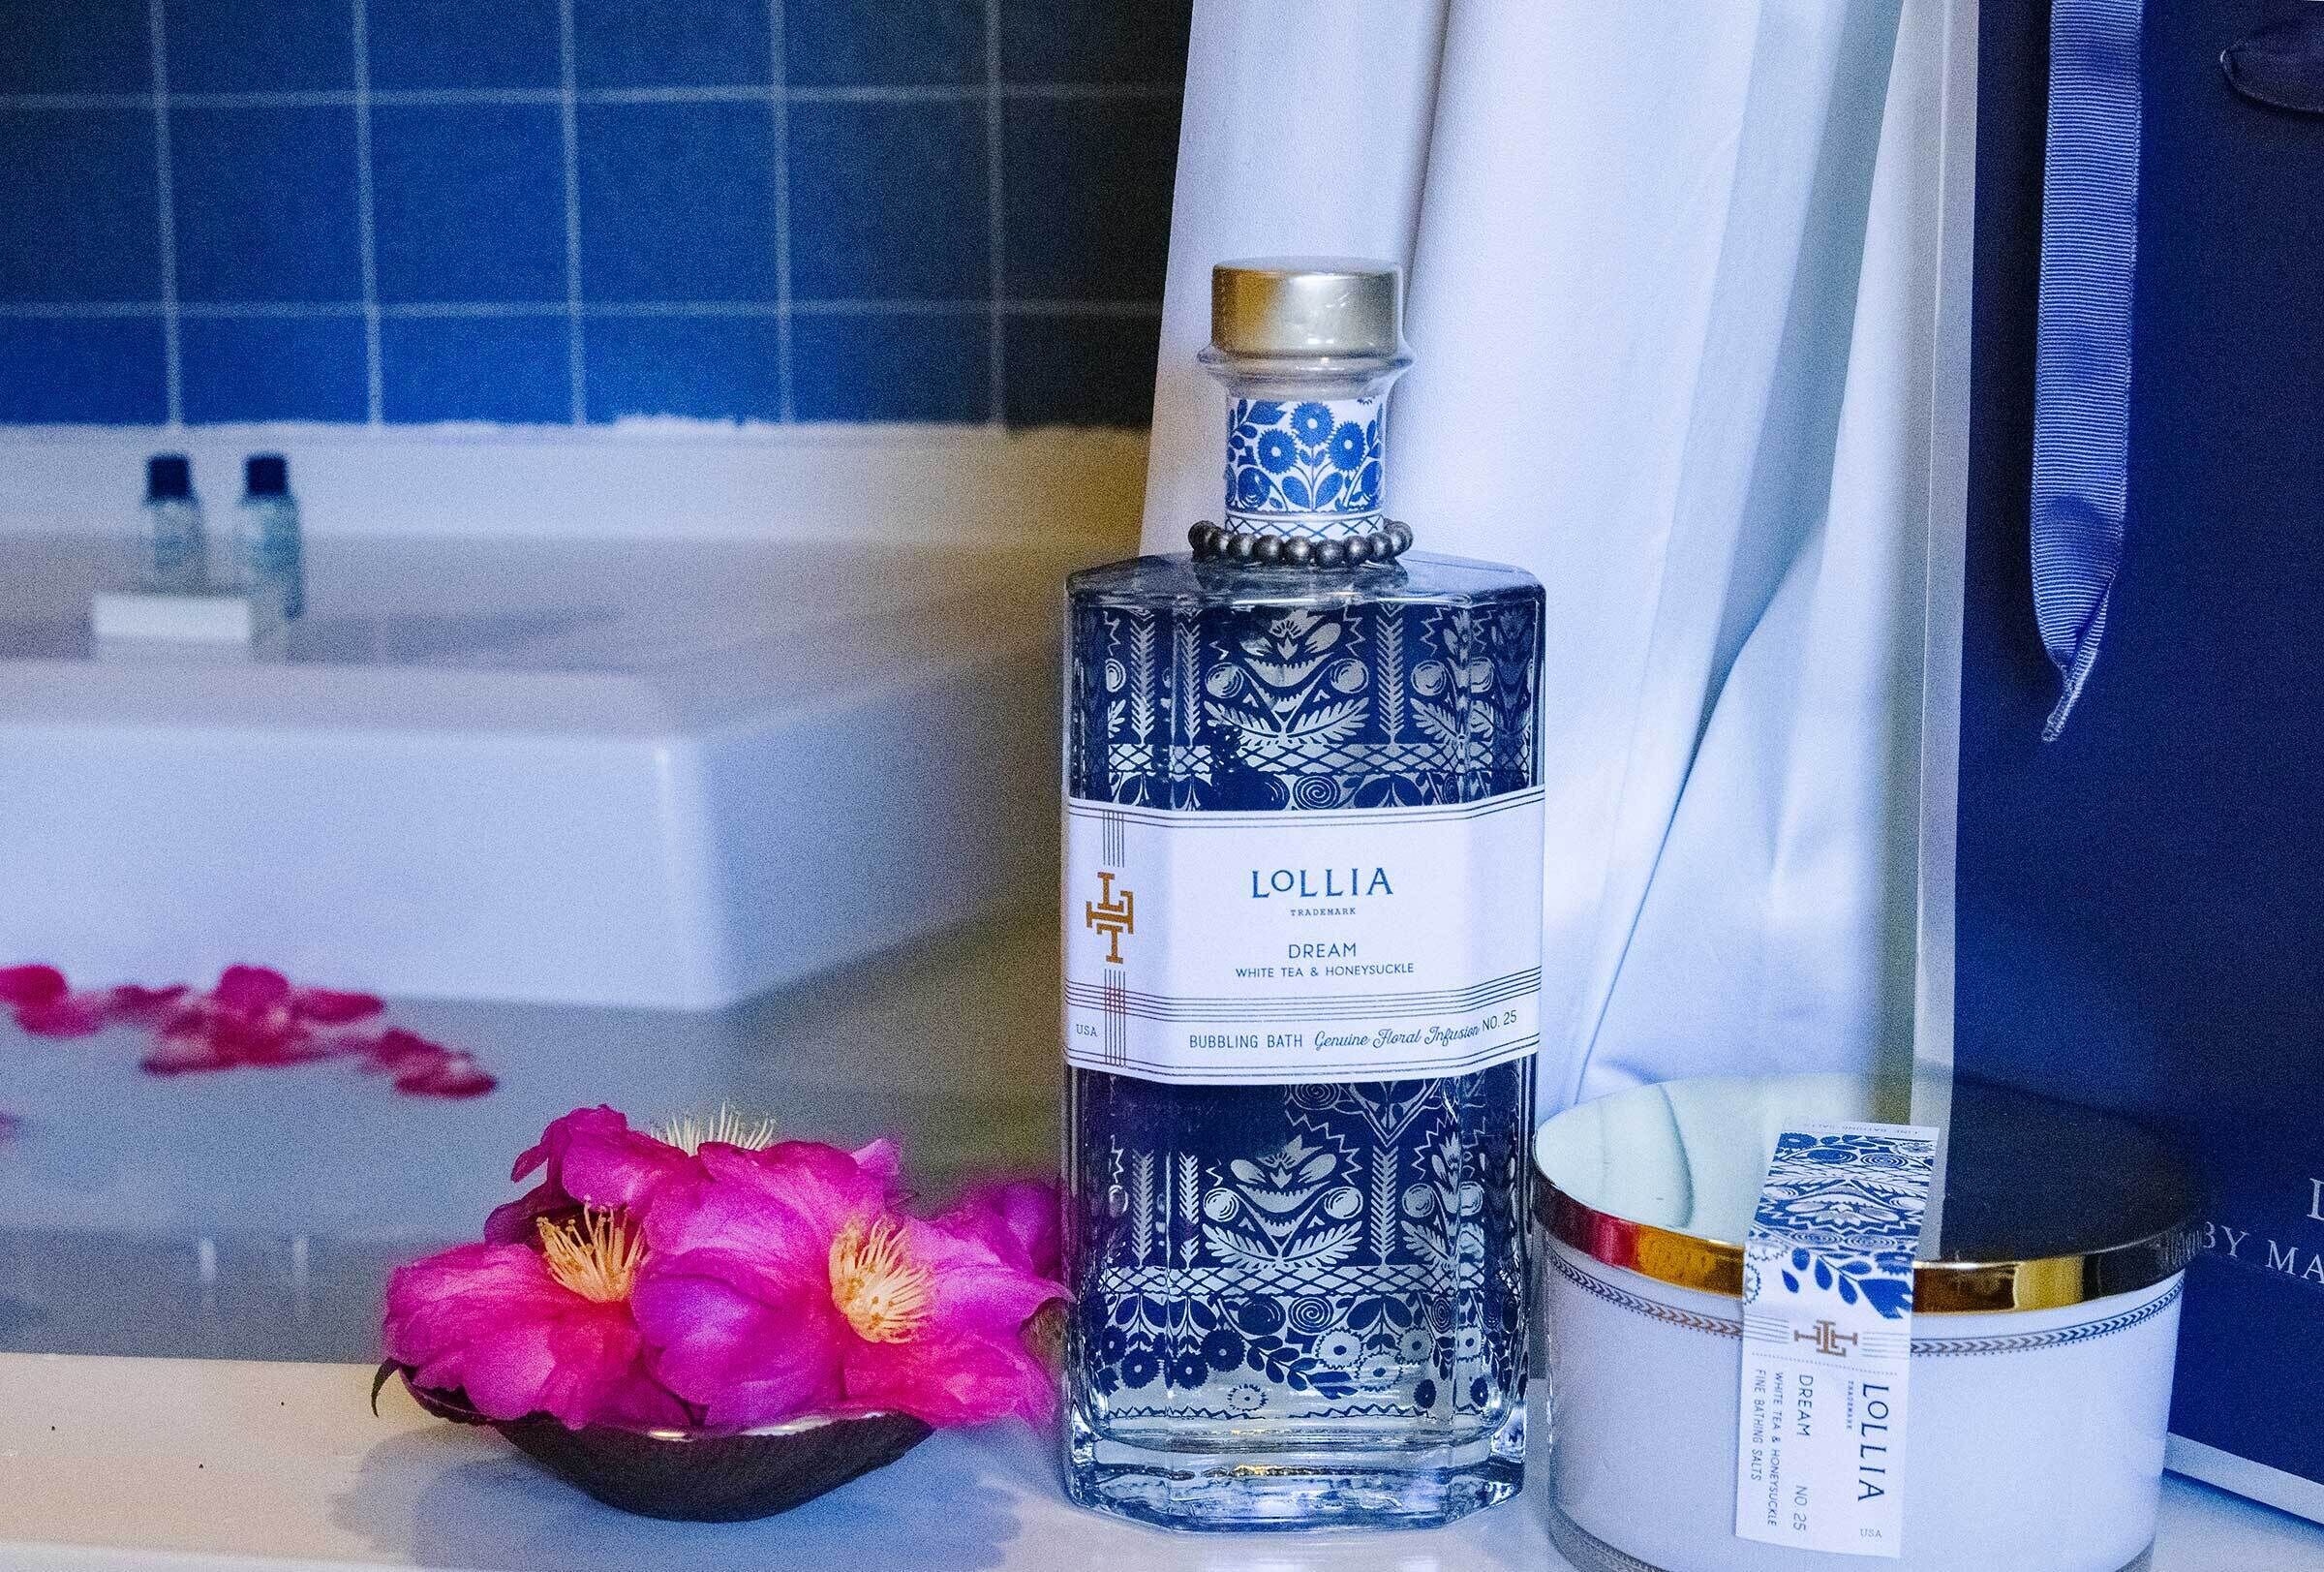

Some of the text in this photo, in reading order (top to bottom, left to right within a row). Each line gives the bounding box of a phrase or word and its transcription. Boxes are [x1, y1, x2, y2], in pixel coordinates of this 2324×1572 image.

[1252, 868, 1393, 898] LOLLIA
[1290, 908, 1356, 916] TRADEMARK
[1289, 943, 1356, 958] DREAM
[1236, 964, 1414, 977] WHITE TEA & HONEYSUCKLE
[1076, 1024, 1097, 1037] USA
[1189, 1010, 1516, 1051] BUBBLING BATH Genuine Floral Infusion NO. 25
[1773, 1372, 1784, 1404] WHITE
[1797, 1374, 1814, 1436] DREAM
[1751, 1369, 1766, 1481] FINE BATHING SALTS
[1772, 1411, 1783, 1430] TEA
[1857, 1383, 1889, 1502] LOLLIA
[1767, 1449, 1781, 1526] HONEYSUCKLE
[1793, 1512, 1807, 1531] 25
[1860, 1528, 1882, 1538] USA
